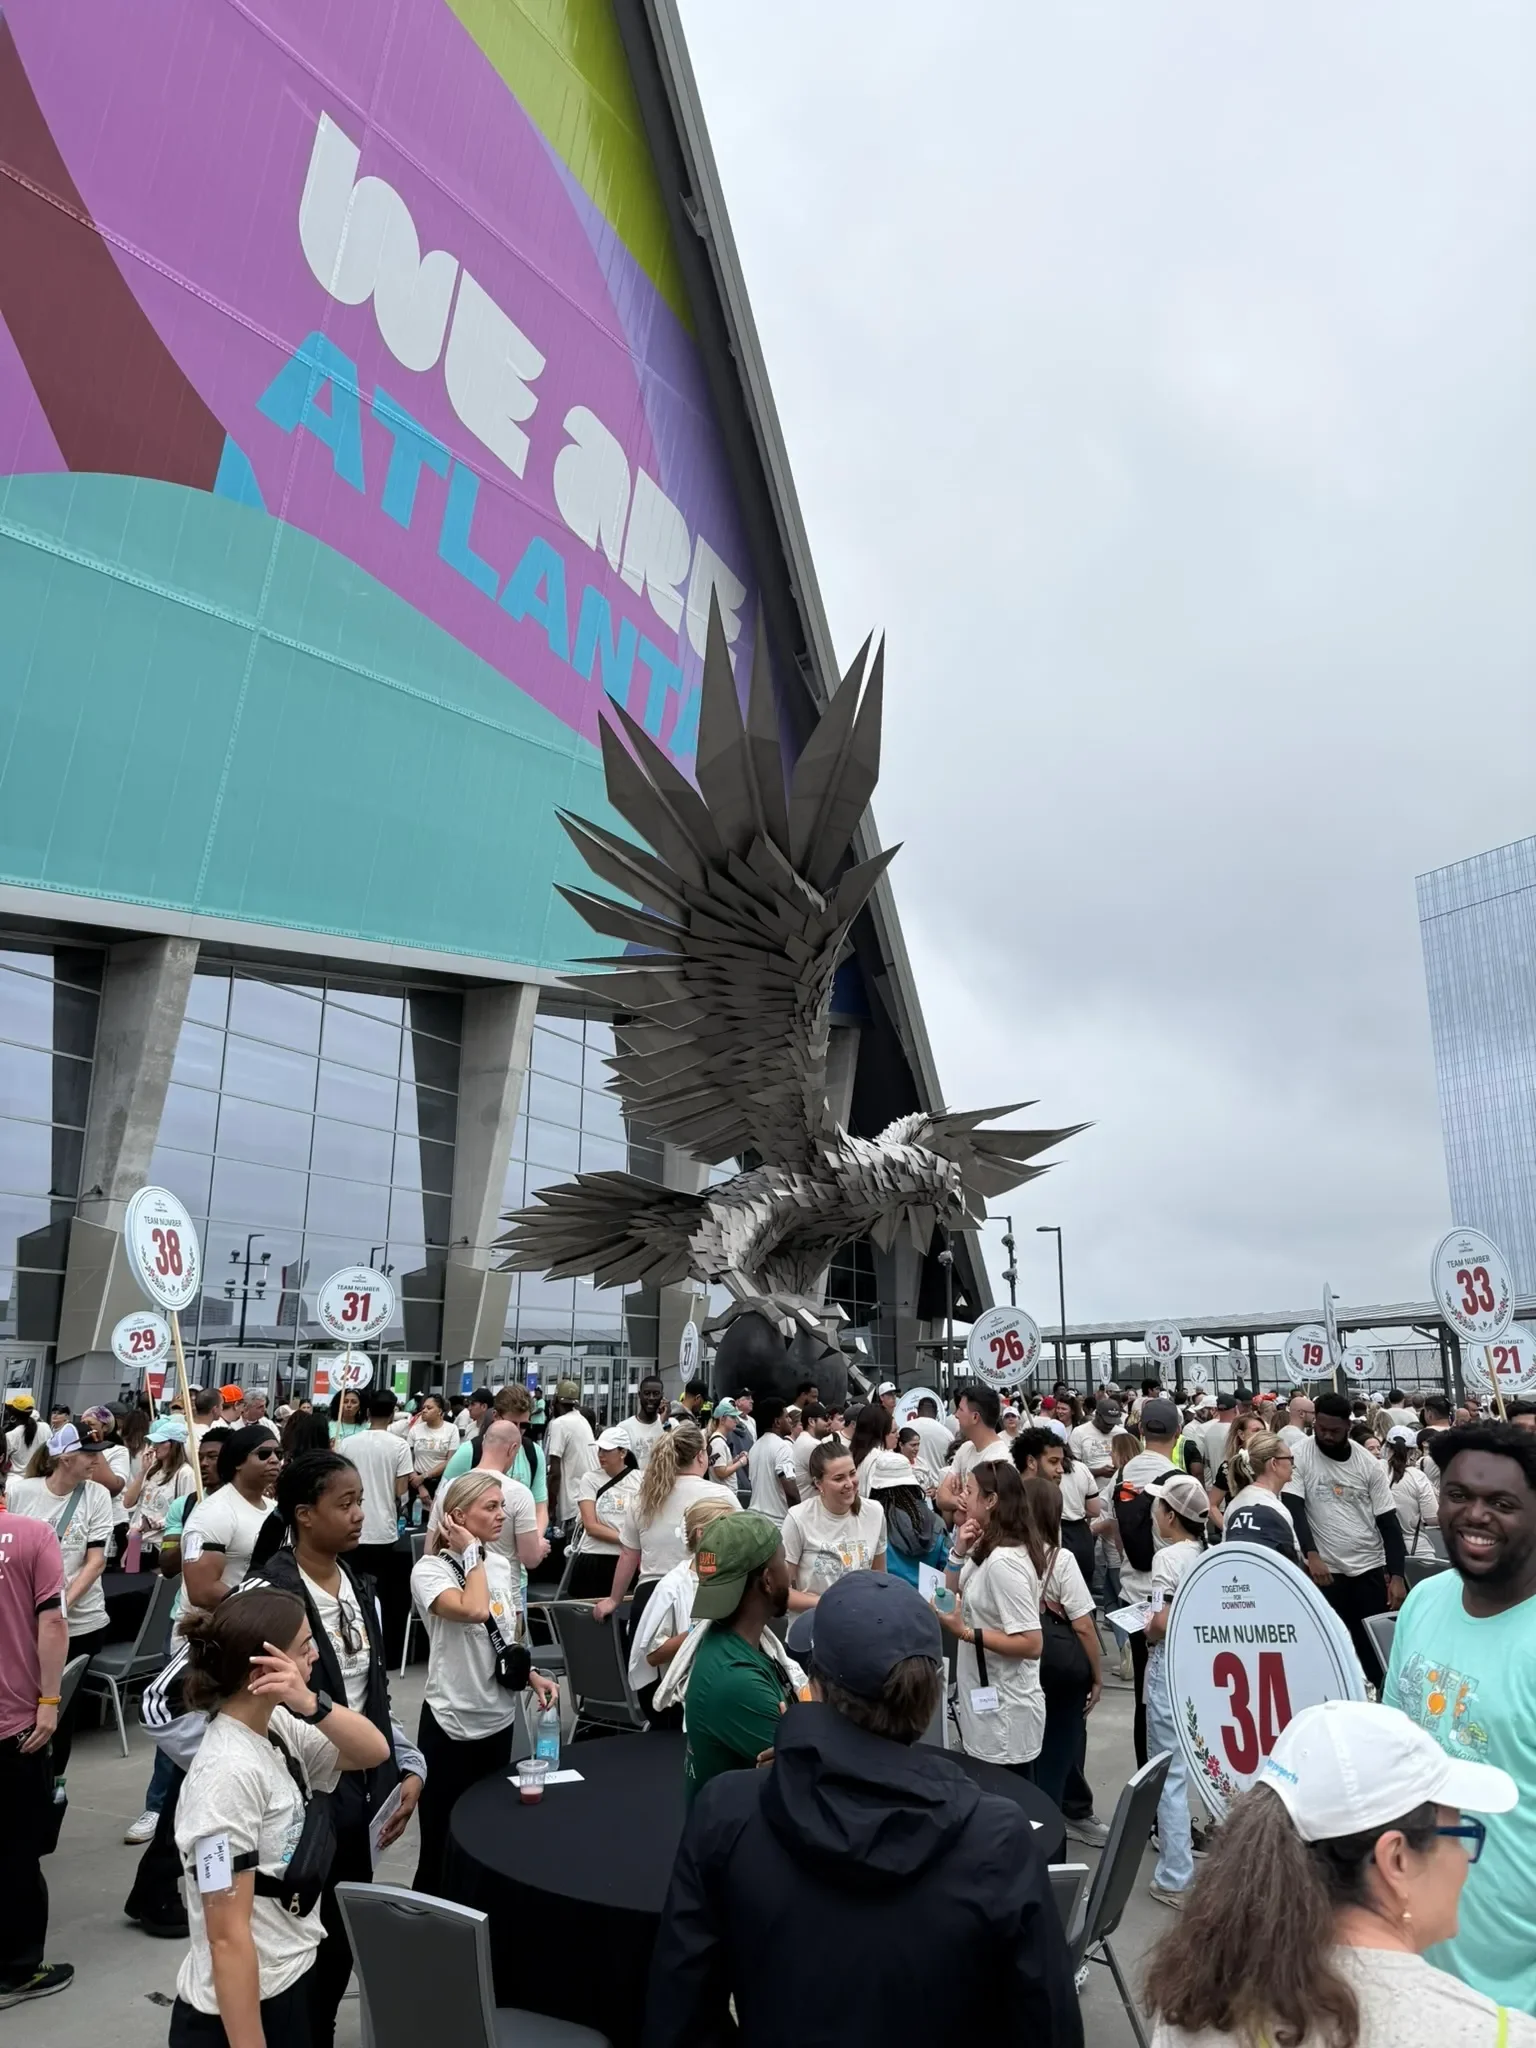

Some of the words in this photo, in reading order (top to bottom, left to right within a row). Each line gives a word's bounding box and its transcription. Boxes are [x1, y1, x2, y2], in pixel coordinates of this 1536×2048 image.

[299, 110, 547, 480] WE
[143, 1216, 159, 1225] TEAM
[159, 1218, 182, 1228] NUMBER
[152, 1228, 183, 1276] 38
[1446, 1259, 1464, 1269] TEAM
[1464, 1254, 1491, 1265] NUMBER
[1456, 1266, 1495, 1316] 33
[341, 1292, 371, 1322] 31
[129, 1329, 156, 1353] 29
[980, 1331, 996, 1341] TEAM
[996, 1320, 1020, 1334] NUMBER
[990, 1330, 1024, 1369] 26
[1155, 1335, 1170, 1352] 13
[1236, 1359, 1242, 1370] 2
[1302, 1343, 1323, 1366] 19
[1355, 1356, 1363, 1371] 9
[1492, 1345, 1522, 1374] 21
[1230, 1512, 1261, 1530] ATL
[1221, 1584, 1250, 1593] TOGETHER
[1221, 1601, 1256, 1609] DOWNTOWN
[1193, 1625, 1231, 1643] TEAM
[1233, 1624, 1298, 1643] NUMBER
[1213, 1651, 1292, 1775] 34
